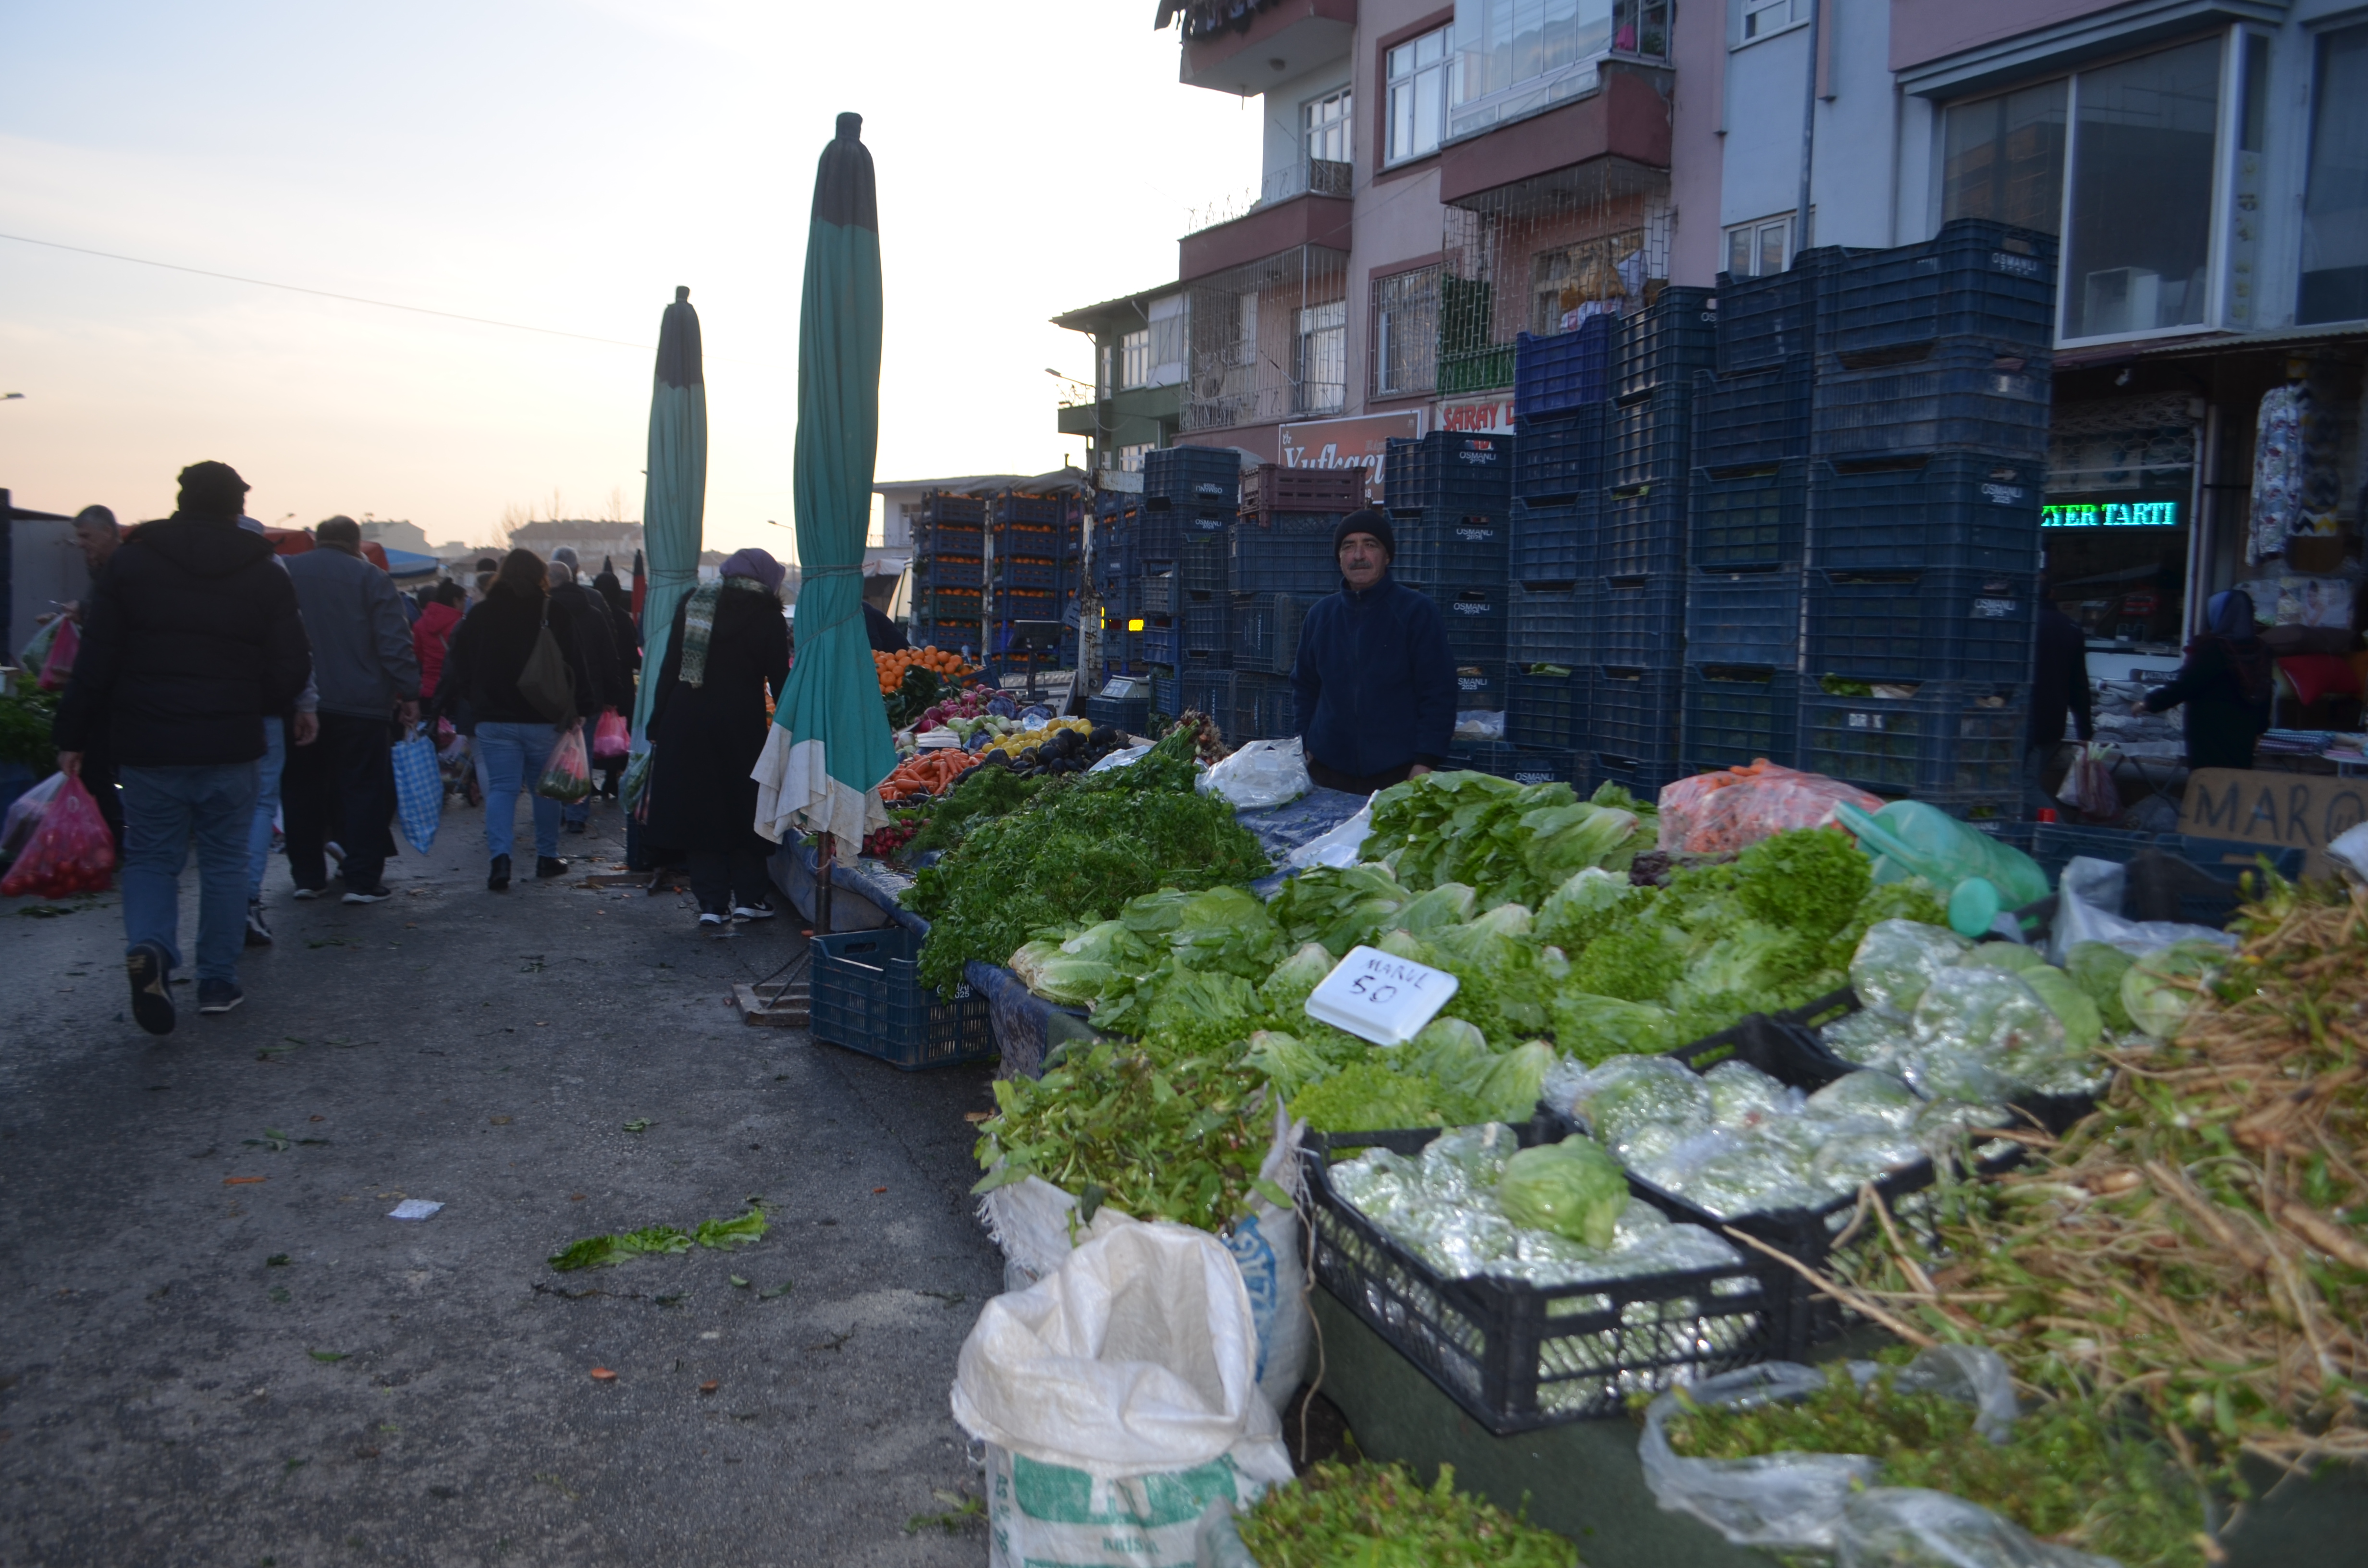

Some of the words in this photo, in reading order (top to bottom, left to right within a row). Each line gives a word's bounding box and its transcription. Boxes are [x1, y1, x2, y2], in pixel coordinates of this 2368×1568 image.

[1991, 252, 2037, 272] OSMANLI
[1443, 401, 1500, 432] SARAY
[1459, 451, 1496, 461] OSMANLI
[1196, 485, 1222, 493] OSMANLI
[1981, 483, 2023, 498] OSMANLI
[1195, 519, 1221, 527] OSMANLI
[1455, 528, 1493, 537] OSMANLI
[1453, 602, 1490, 612] OSMANLI
[1973, 599, 2016, 611] OSMANLI
[1457, 677, 1488, 686] SMANLI
[1515, 772, 1554, 782] OSMANLI
[1367, 958, 1431, 992] MARUL
[1349, 974, 1397, 1004] 50
[954, 991, 970, 999] 025
